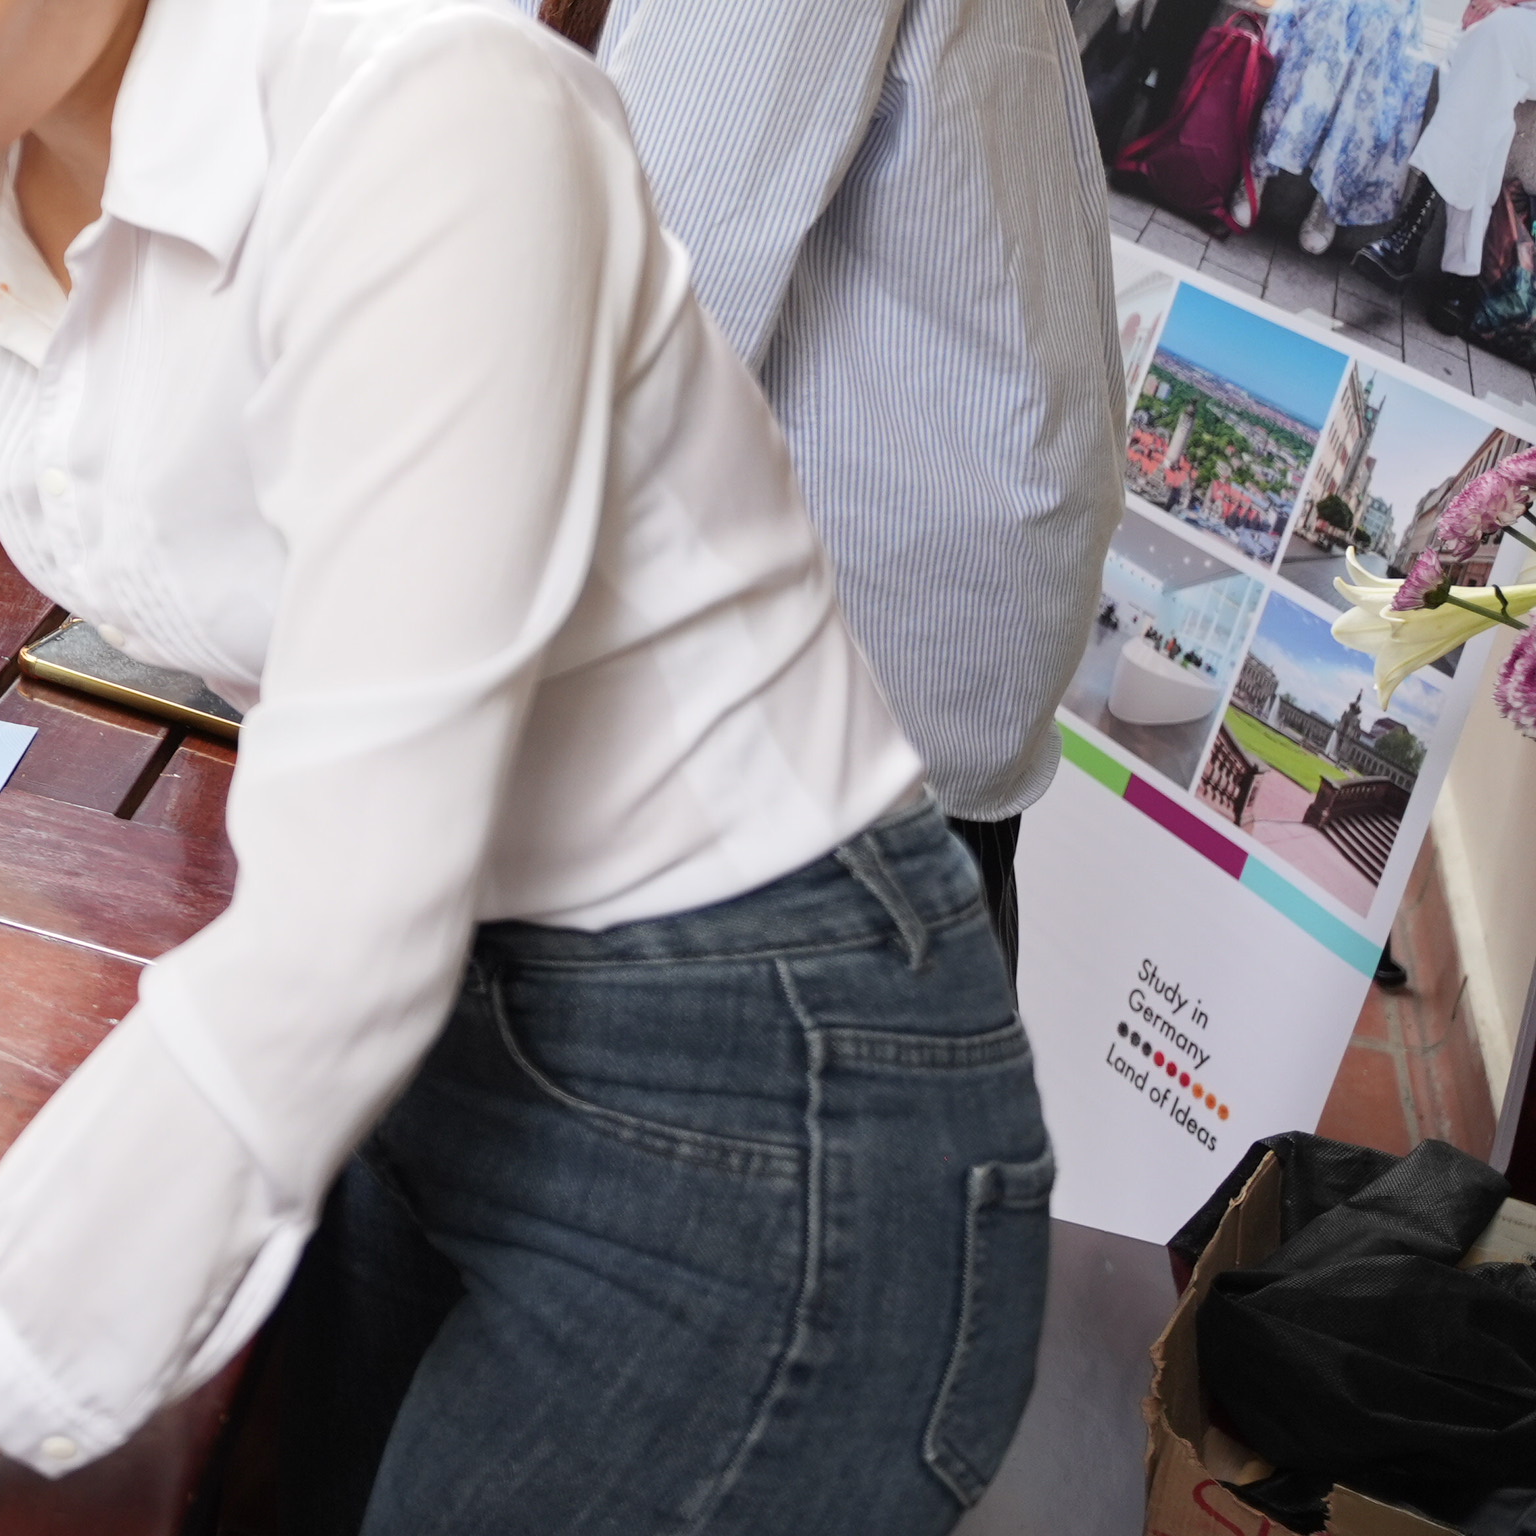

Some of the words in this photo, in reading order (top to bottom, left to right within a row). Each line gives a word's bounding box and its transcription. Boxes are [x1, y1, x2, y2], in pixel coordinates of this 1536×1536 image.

[1128, 988, 1210, 1069] Germany
[1137, 958, 1188, 1014] Study
[1191, 999, 1209, 1030] in
[1106, 1042, 1149, 1091] Land
[1149, 1086, 1172, 1109] of
[1169, 1097, 1218, 1152] Ideas
